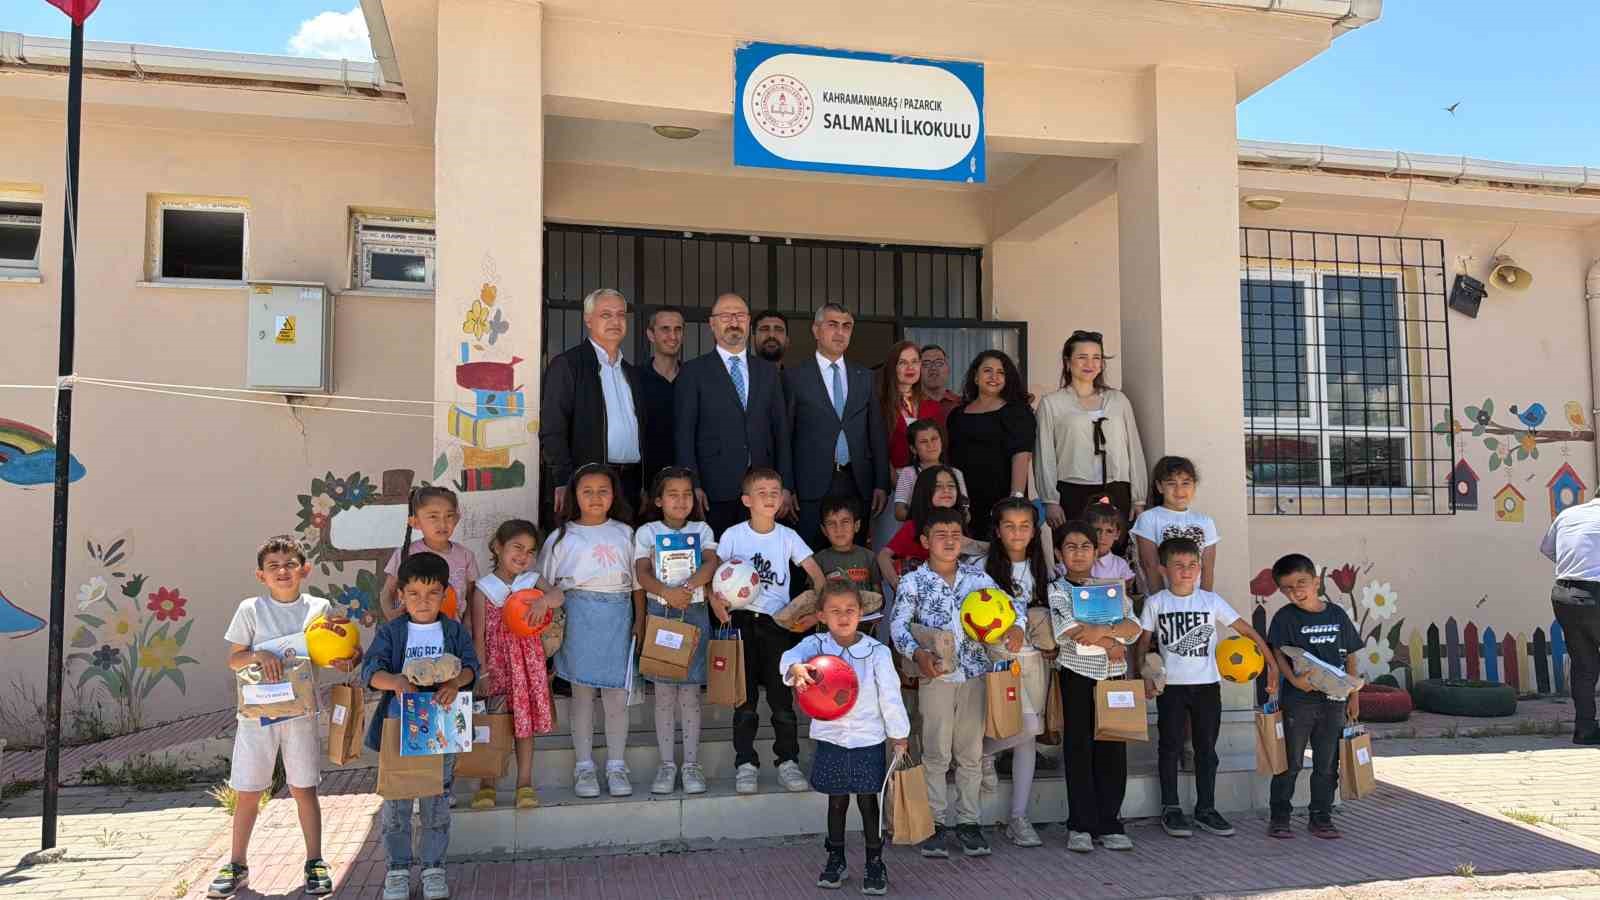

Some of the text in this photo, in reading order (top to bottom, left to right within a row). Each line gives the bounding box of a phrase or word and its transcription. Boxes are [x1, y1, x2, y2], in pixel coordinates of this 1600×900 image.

[823, 91, 898, 110] KAHRAMANMARAŞ
[904, 98, 943, 111] PAZARCIK
[823, 113, 972, 139] SALMANLI İLKOKULU
[1158, 611, 1210, 645] STREET
[1301, 624, 1341, 634] GAME
[1310, 635, 1337, 643] DAY
[406, 646, 423, 658] ONG
